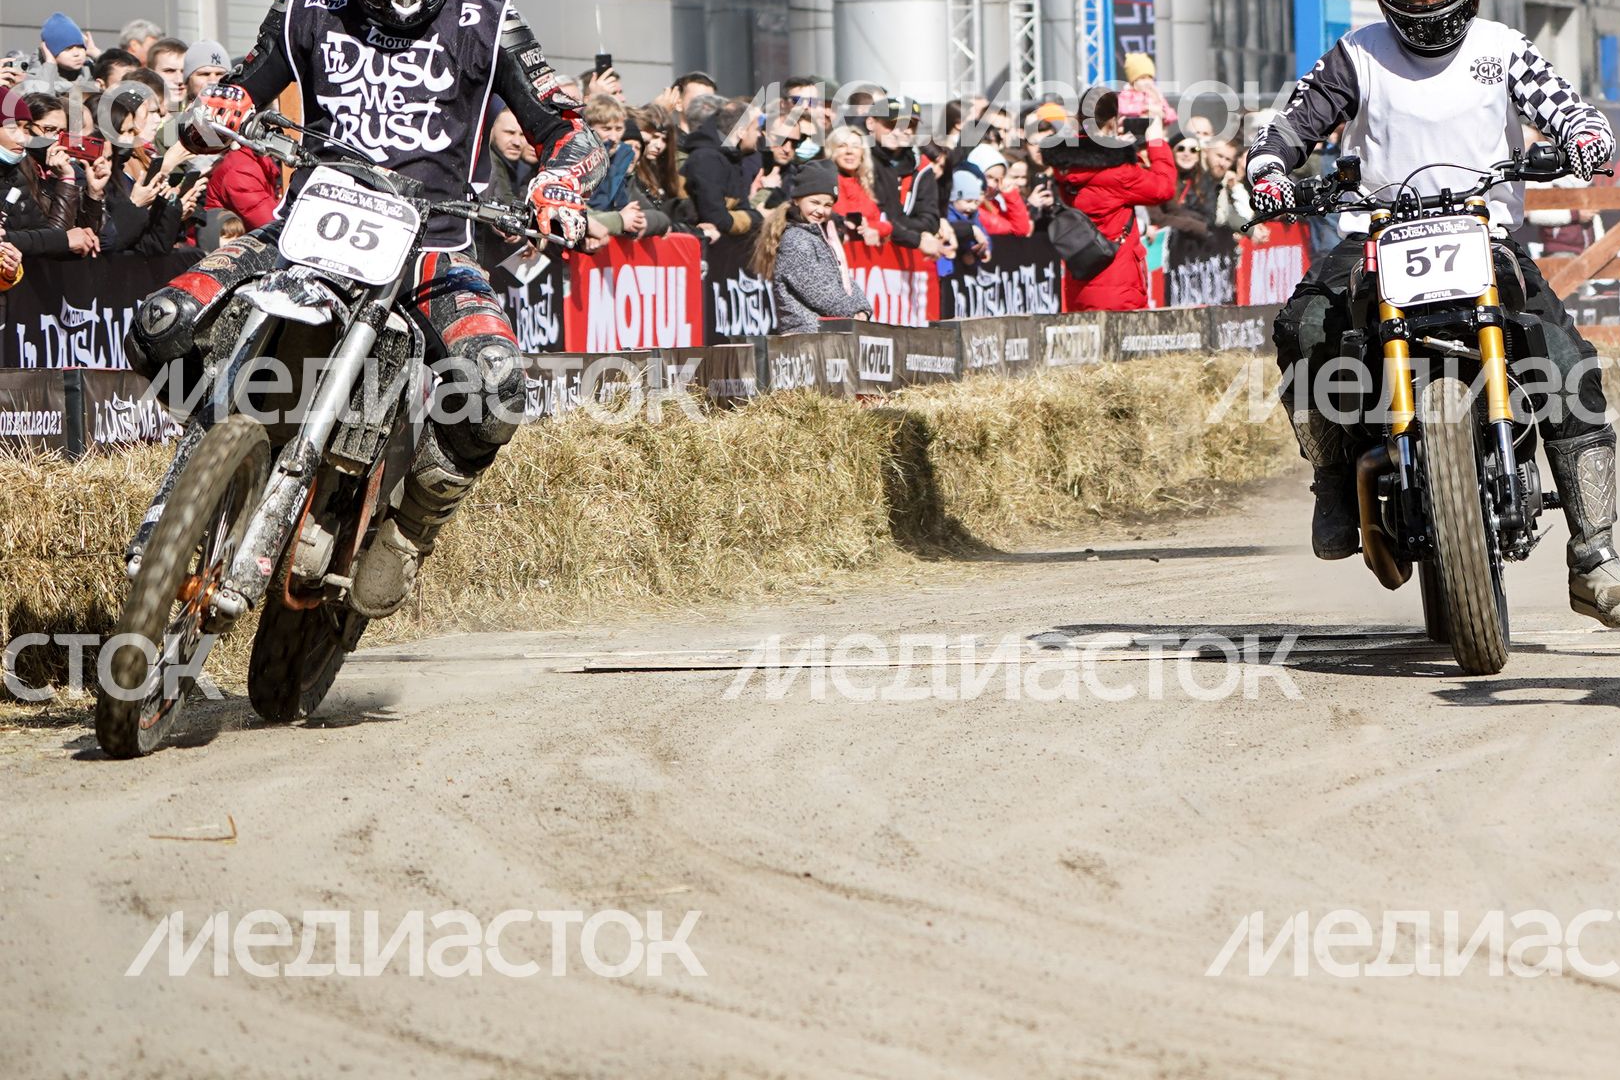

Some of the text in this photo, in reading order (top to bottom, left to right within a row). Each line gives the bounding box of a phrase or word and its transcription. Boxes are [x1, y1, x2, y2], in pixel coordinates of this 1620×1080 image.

[458, 3, 482, 27] 5
[370, 32, 414, 49] MOTUL
[329, 187, 357, 204] Dust
[316, 211, 385, 251] 05
[1400, 225, 1426, 240] Dust
[1406, 243, 1461, 278] 57
[586, 264, 692, 353] MOTUL
[1423, 290, 1452, 300] MOTUL
[40, 297, 107, 369] Dust
[861, 342, 891, 375] MOTUL
